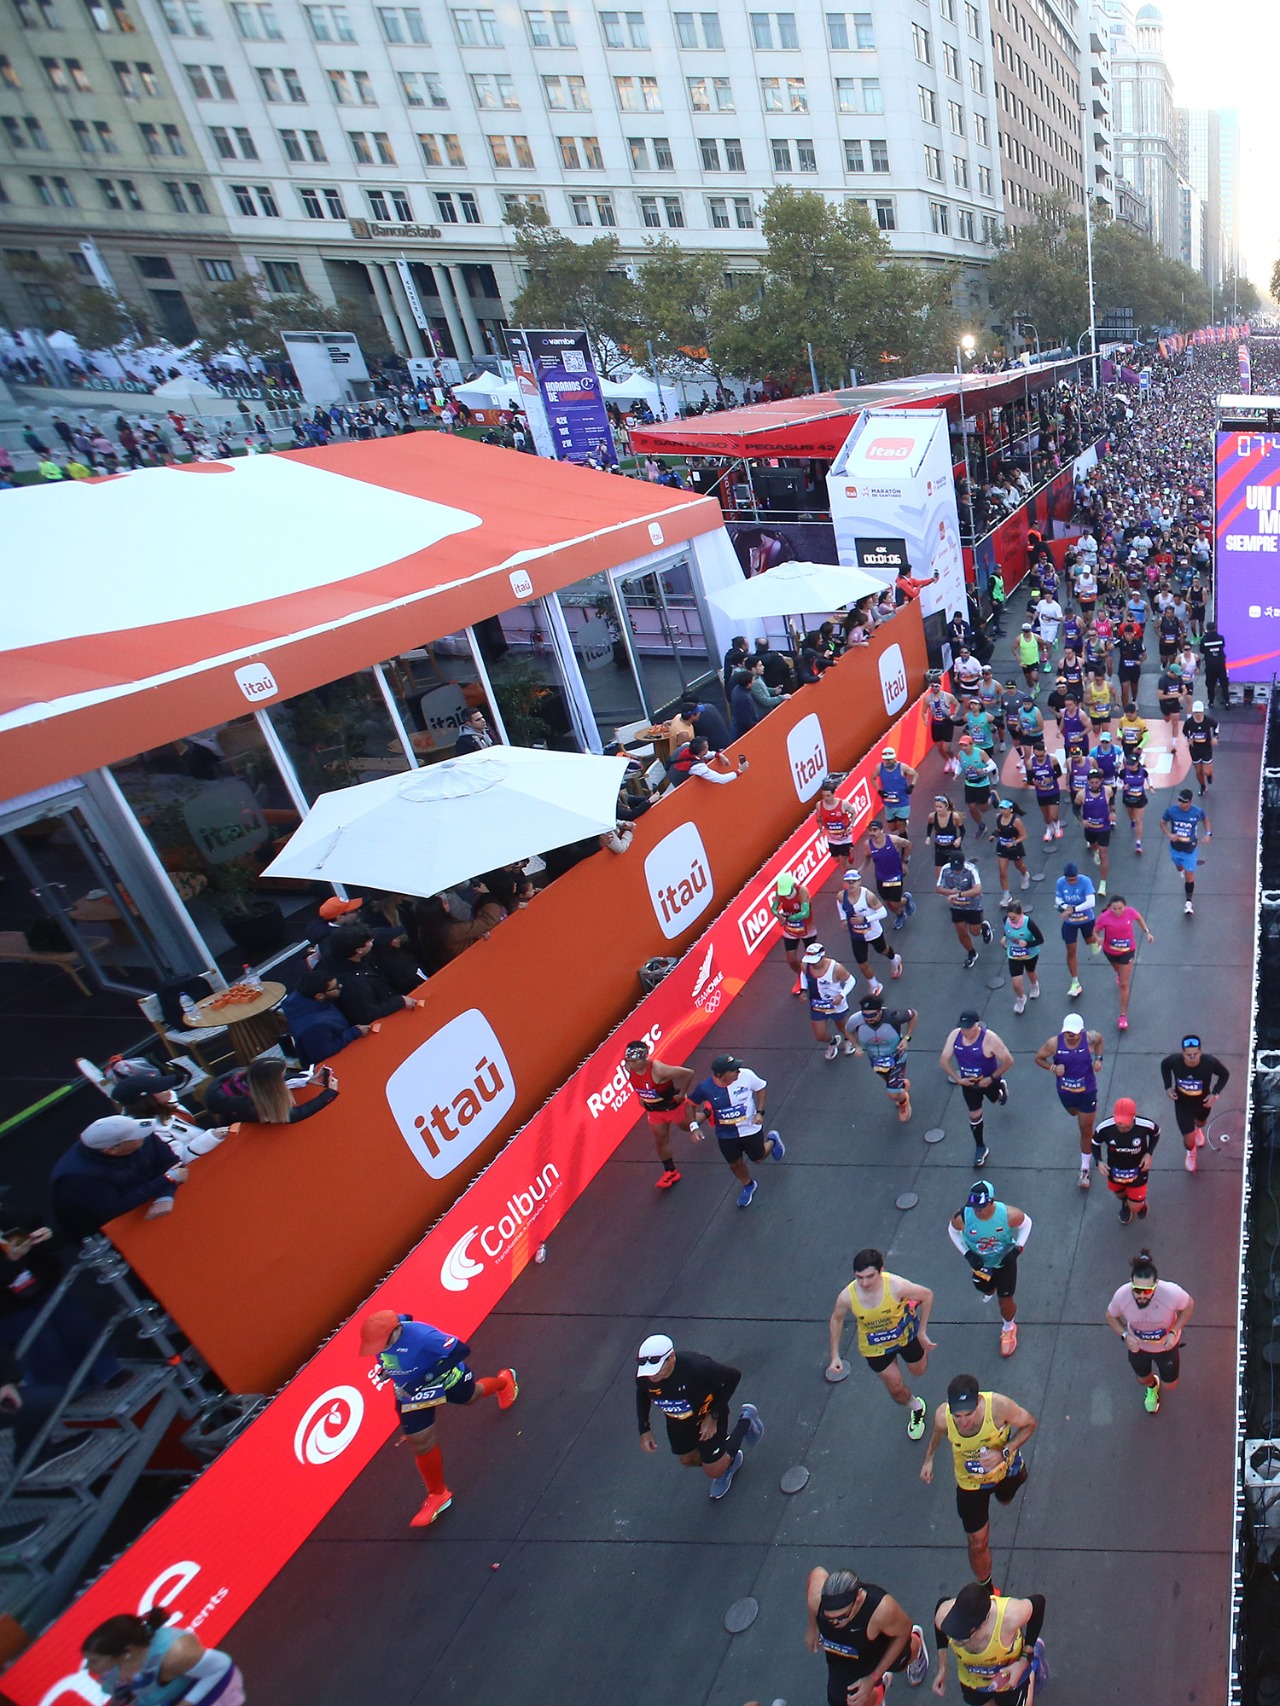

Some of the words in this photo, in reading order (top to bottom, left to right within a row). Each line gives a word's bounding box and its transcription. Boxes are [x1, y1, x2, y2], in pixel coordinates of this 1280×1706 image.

[371, 223, 442, 239] BancoEstado
[549, 338, 576, 346] vambe
[544, 380, 581, 393] HORARIOS
[547, 391, 560, 403] DE
[653, 439, 729, 450] SANTIAGO
[745, 443, 815, 451] PEGASUS
[818, 444, 836, 452] 42
[868, 446, 909, 457] itaú
[1245, 485, 1272, 511] UN
[1225, 534, 1279, 553] SIEMPRE
[512, 576, 531, 594] itaú
[241, 676, 273, 697] itaú
[884, 669, 905, 705] itaú
[795, 743, 824, 790] itaú
[657, 859, 708, 923] itaú
[746, 908, 769, 940] No
[586, 1022, 663, 1119] Radi3c
[413, 1055, 506, 1160] itaú
[720, 1110, 741, 1119] 1450
[479, 1162, 561, 1257] Colbun
